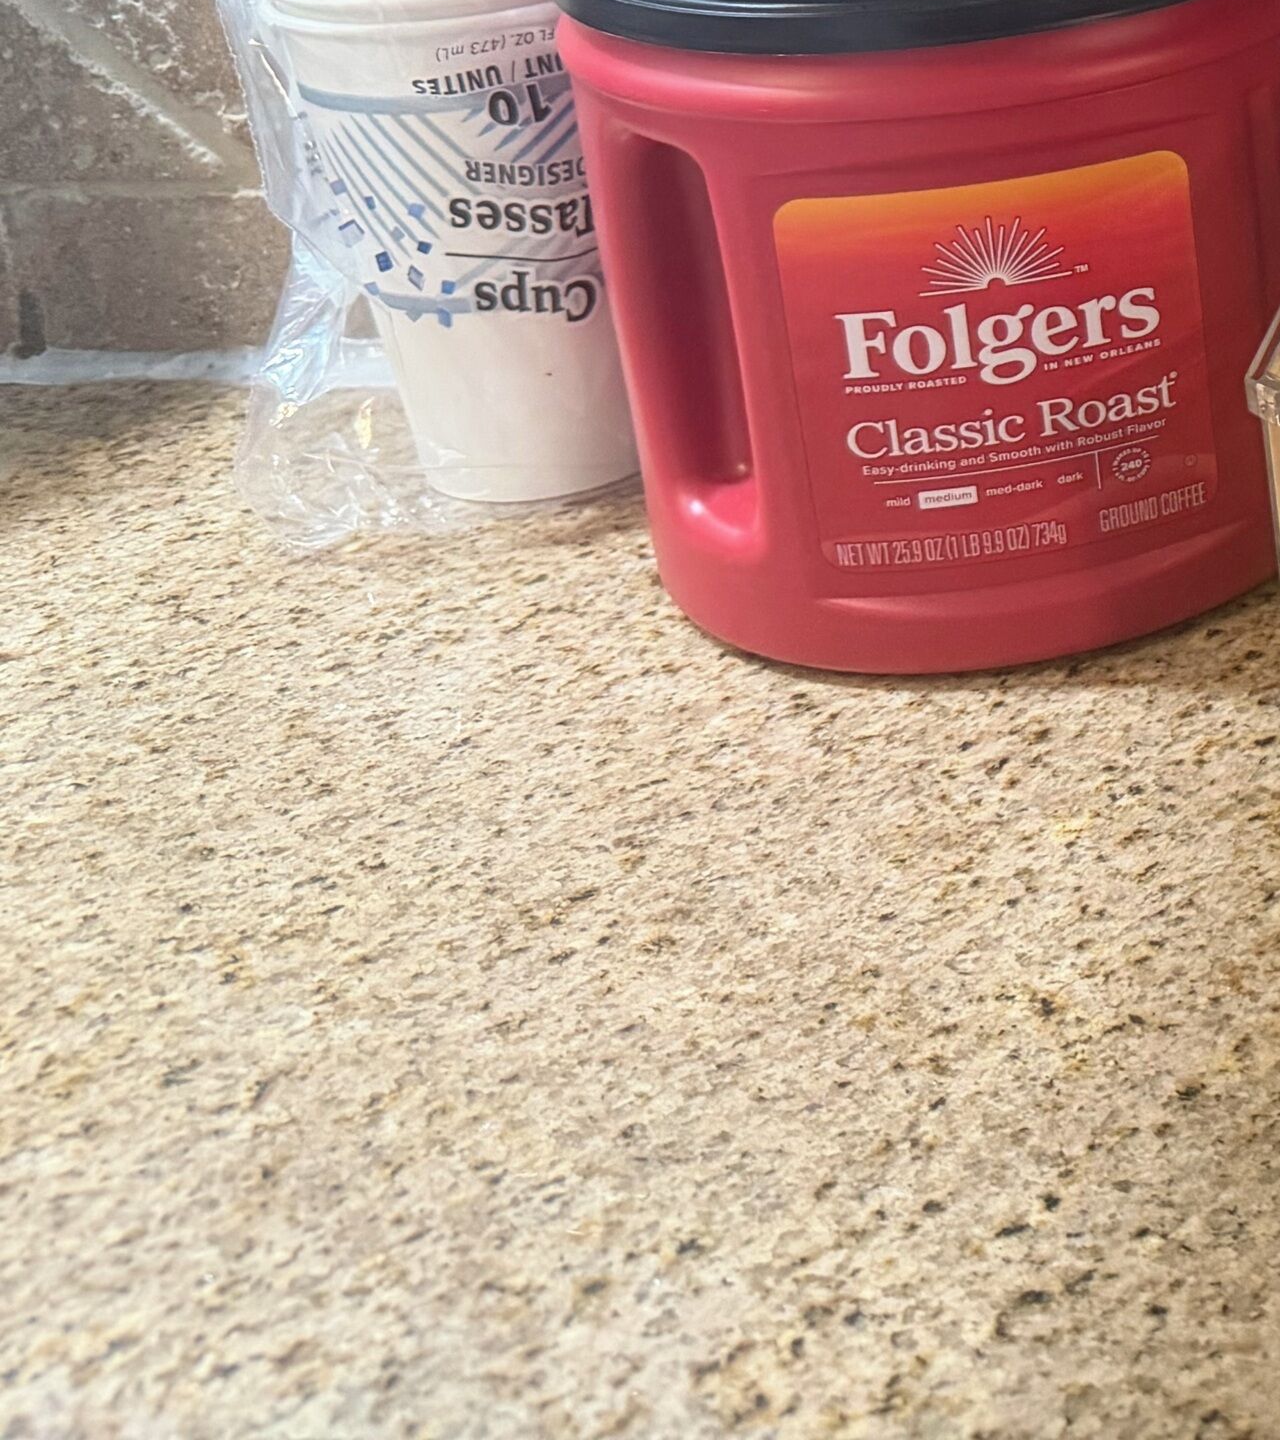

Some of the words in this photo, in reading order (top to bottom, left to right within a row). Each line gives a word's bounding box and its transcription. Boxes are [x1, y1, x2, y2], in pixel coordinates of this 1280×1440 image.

[435, 42, 465, 62] mL)
[470, 34, 506, 55] (473
[511, 32, 534, 46] OZ.
[538, 30, 556, 42] FL
[488, 83, 552, 126] 10
[450, 197, 591, 237] Tasses
[475, 270, 595, 322] Cups
[835, 286, 1160, 385] Folgers
[845, 382, 903, 394] PROUDLY
[908, 376, 967, 390] ROASTED
[1044, 362, 1058, 371] IN
[1065, 355, 1093, 367] NEW
[1100, 339, 1160, 359] ORLEANS
[847, 408, 1025, 460] Classic
[862, 453, 957, 477] Easy-drinking
[961, 454, 985, 466] and
[990, 445, 1041, 463] Smooth
[1045, 441, 1073, 455] with
[1077, 429, 1122, 448] Robust
[1125, 418, 1166, 436] Flavor
[886, 496, 910, 508] mild
[925, 490, 972, 503] medium
[986, 479, 1043, 497] med-dark
[1058, 471, 1083, 485] dark
[1100, 496, 1158, 533] GROUND
[1161, 482, 1206, 519] COFFEE
[836, 542, 866, 566] NET
[870, 541, 890, 563] WT
[893, 538, 922, 562] 25.9
[925, 536, 944, 560] OZ
[964, 531, 981, 557] LB
[982, 529, 1004, 554] 9.9
[1007, 524, 1030, 551] OZ)
[1032, 522, 1067, 547] 734g
